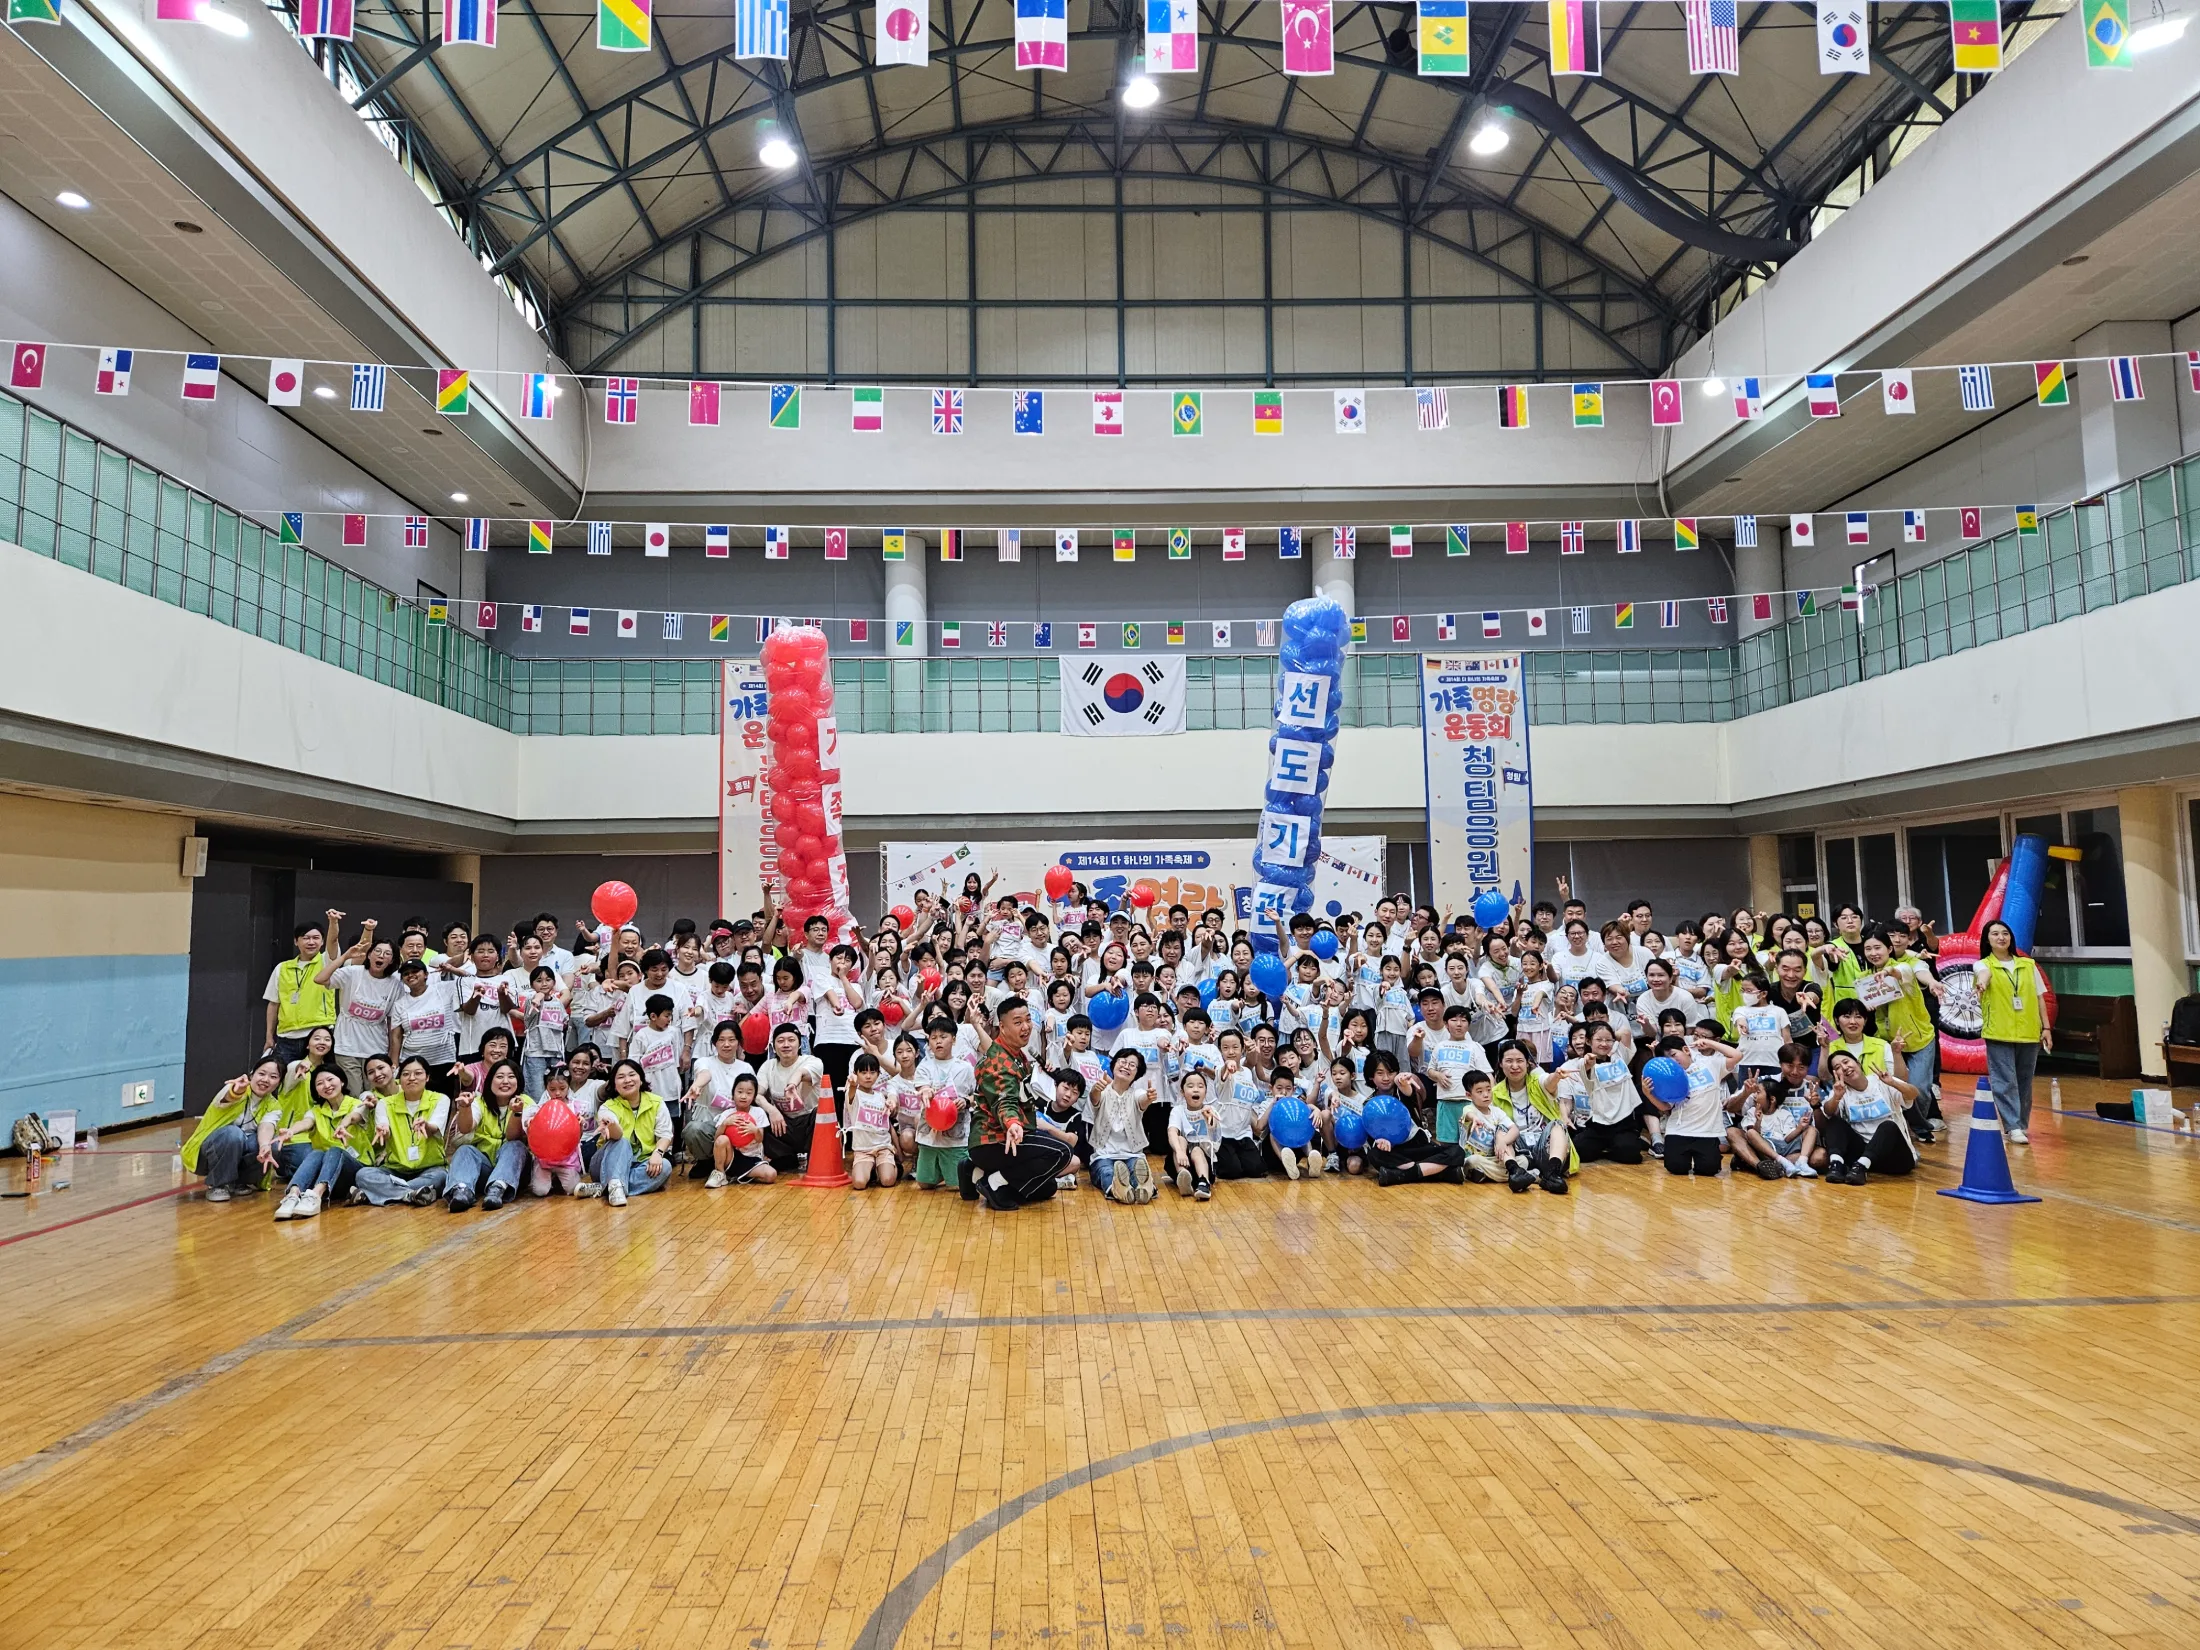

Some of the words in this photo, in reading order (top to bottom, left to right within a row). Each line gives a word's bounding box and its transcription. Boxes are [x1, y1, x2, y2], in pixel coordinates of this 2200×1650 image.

[1429, 685, 1519, 714] 가족명랑
[1443, 713, 1511, 740] 운동회
[1506, 771, 1521, 781] 청팀
[735, 780, 750, 791] 홍팀
[1078, 855, 1109, 866] 제14회
[1111, 855, 1122, 866] 다
[1123, 855, 1152, 866] 하나의
[1155, 854, 1193, 865] 가족축제
[1442, 1049, 1464, 1061] 105
[865, 1111, 884, 1126] 018
[1857, 1105, 1881, 1119] 171
